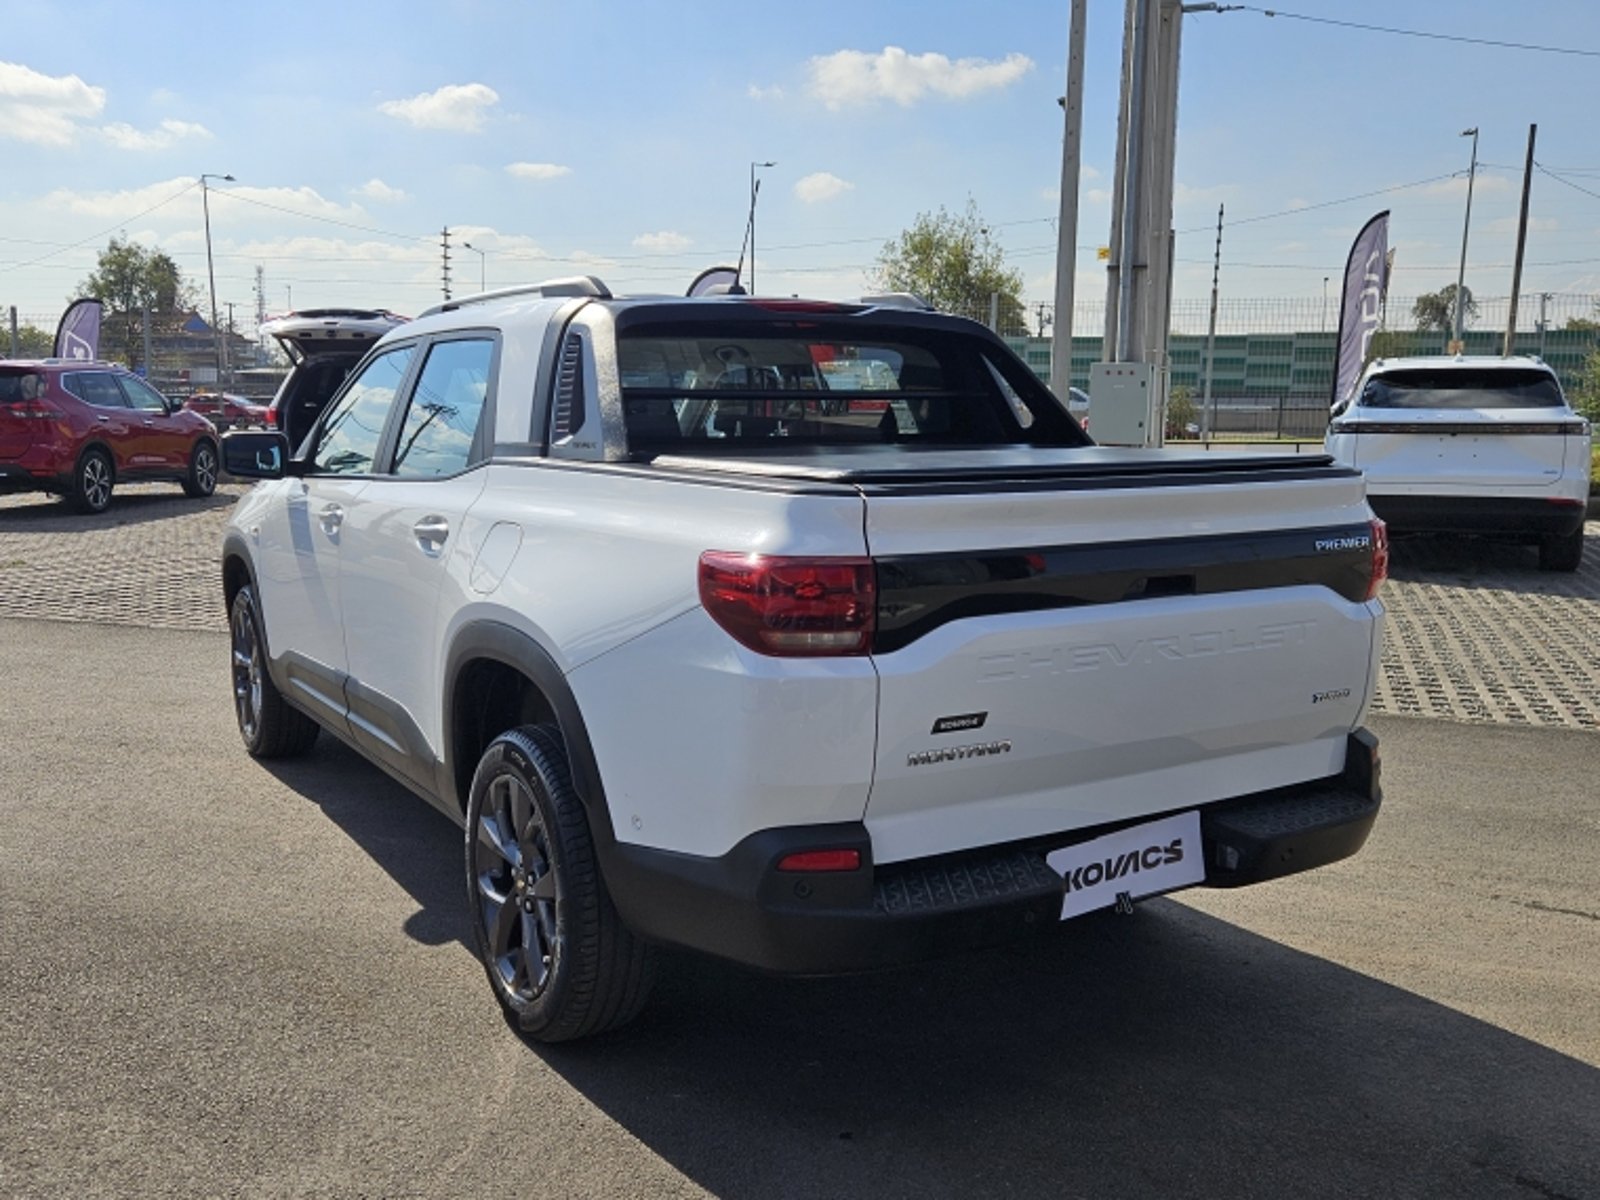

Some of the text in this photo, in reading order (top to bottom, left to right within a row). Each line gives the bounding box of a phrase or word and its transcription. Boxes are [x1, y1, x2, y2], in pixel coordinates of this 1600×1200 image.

[1315, 535, 1370, 552] PREMIER
[976, 619, 1318, 684] CHEVROLET
[907, 739, 1012, 767] MONTANA
[1063, 838, 1184, 893] KOVACS
